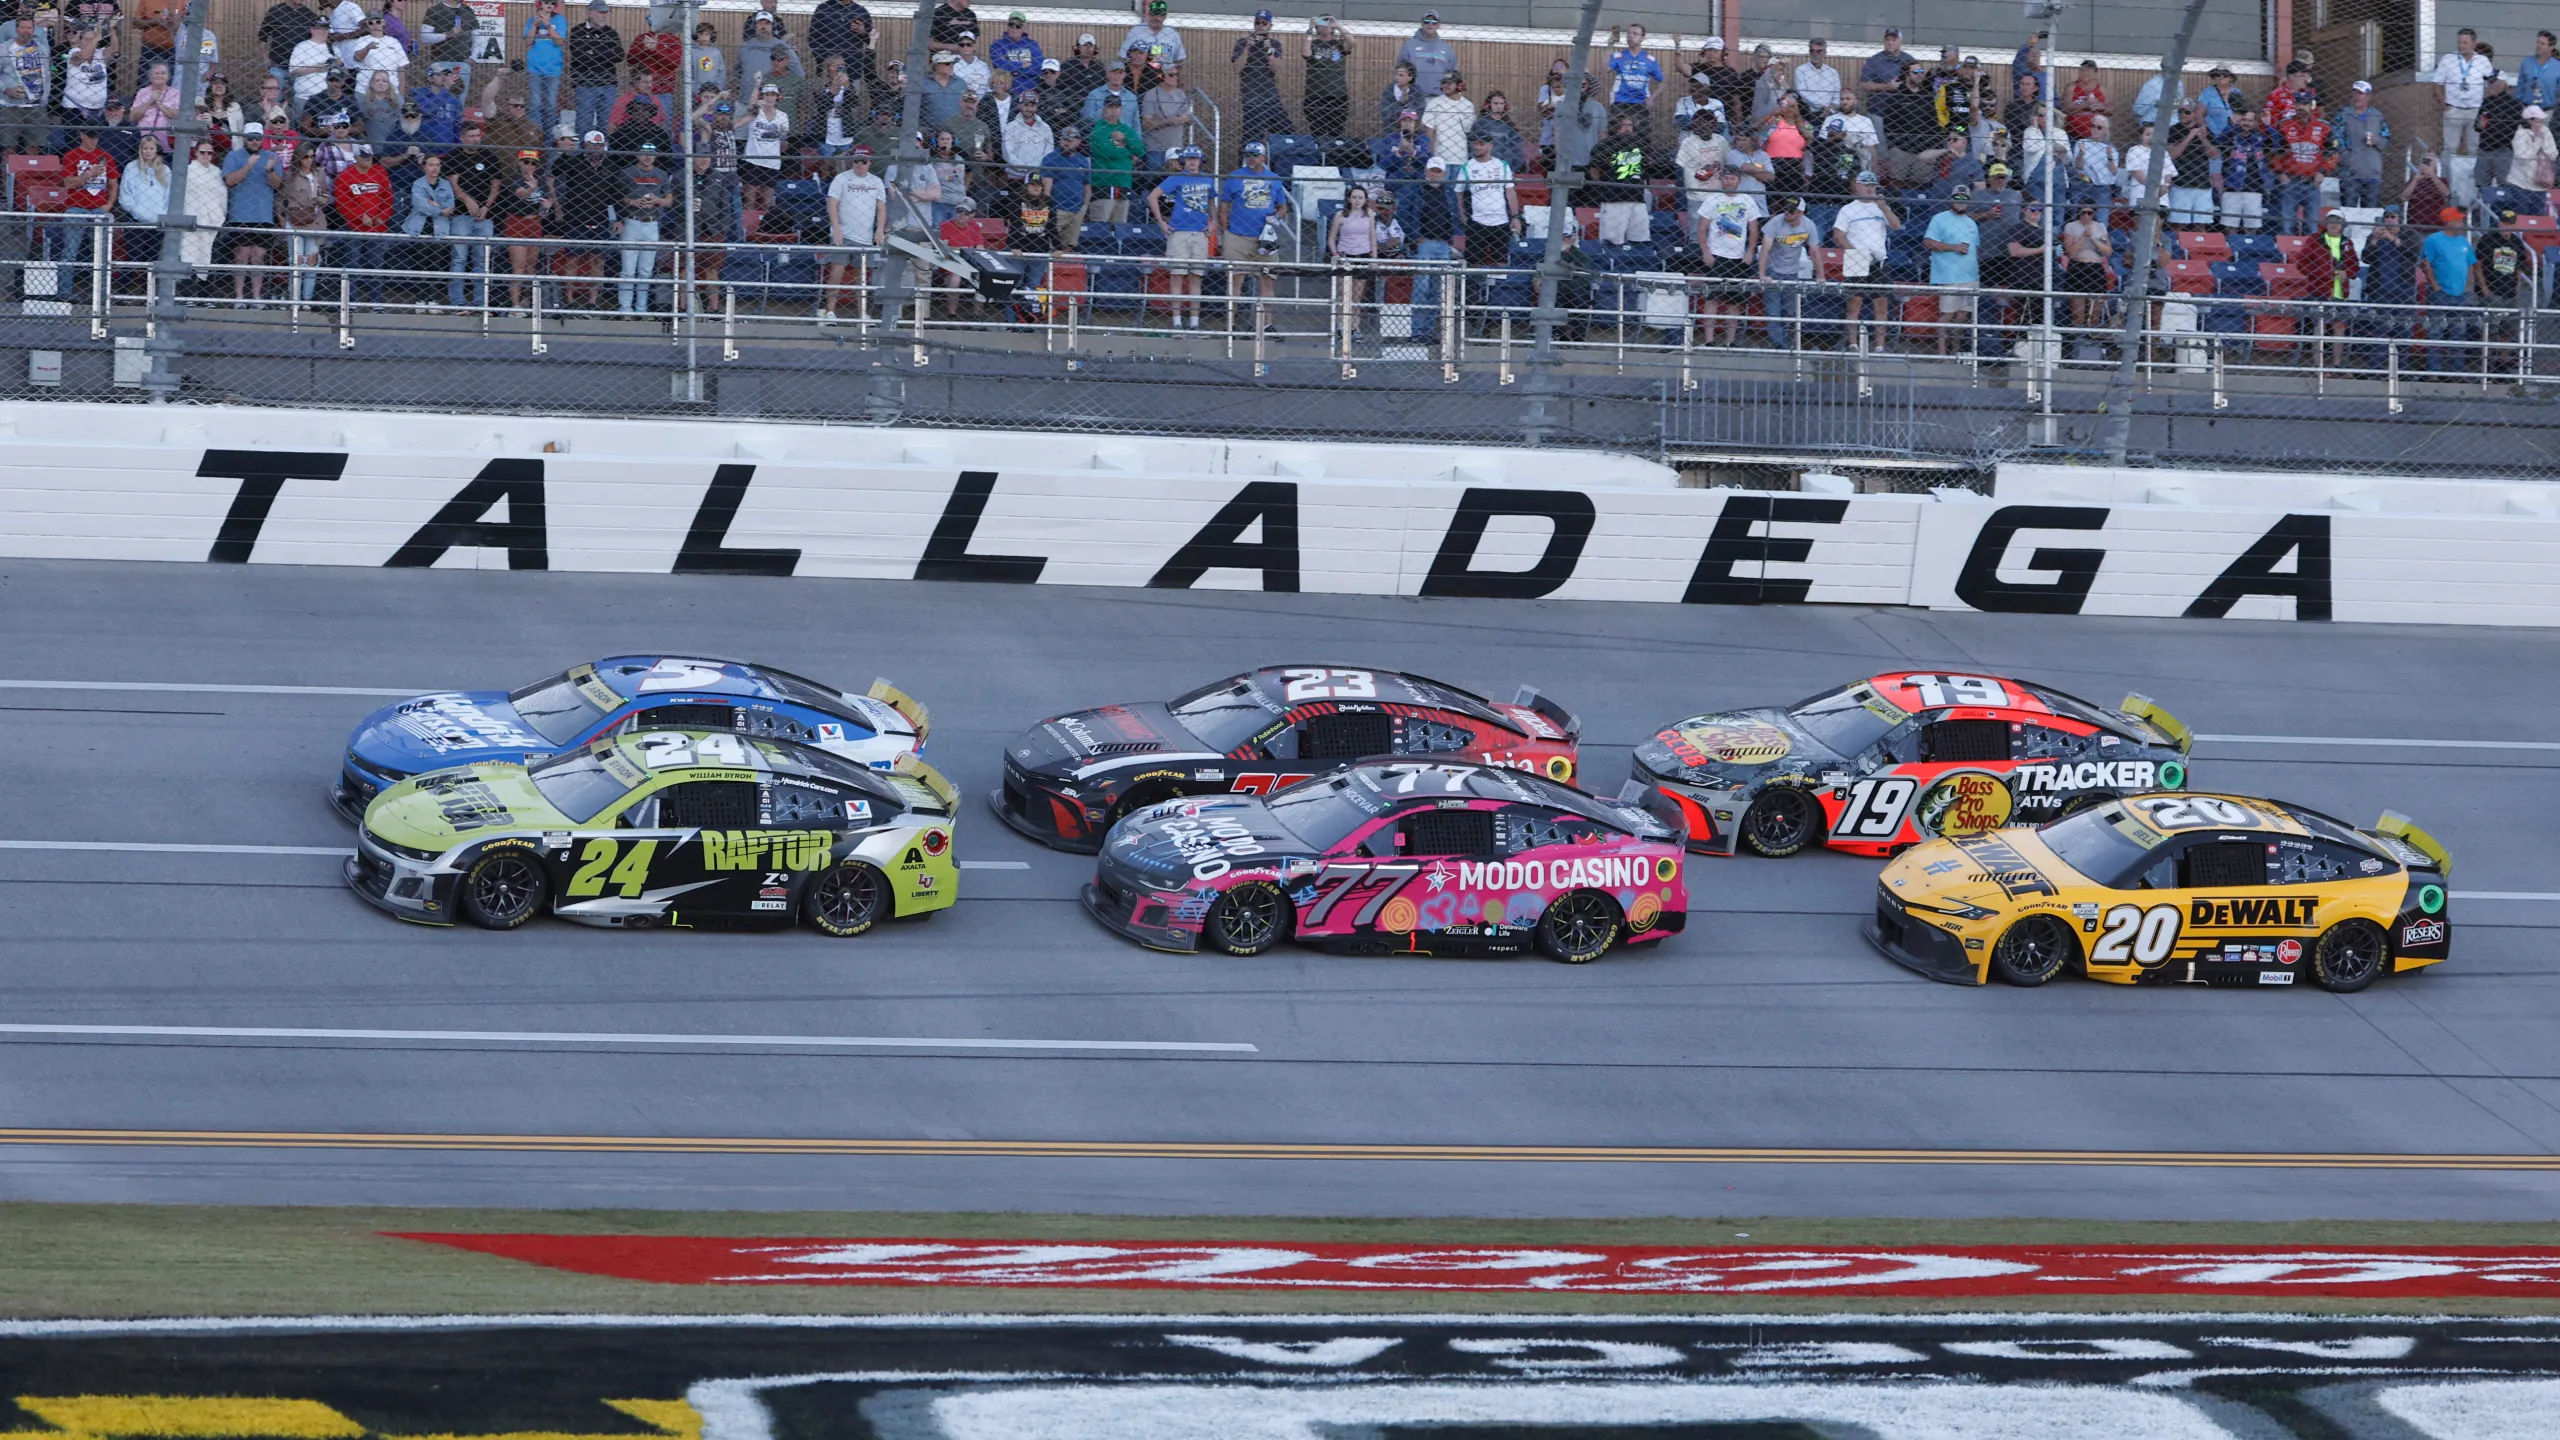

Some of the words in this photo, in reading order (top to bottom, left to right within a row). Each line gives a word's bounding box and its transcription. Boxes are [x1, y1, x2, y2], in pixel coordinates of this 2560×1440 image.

[195, 449, 2332, 621] TALLADEGA
[637, 658, 726, 691] 5
[1285, 667, 1377, 701] 23
[586, 683, 613, 705] LARSON
[1904, 674, 2009, 707] 19
[1250, 689, 1283, 715] WALLACE
[1868, 699, 1903, 722] BRISCOE
[1257, 721, 1285, 741] Robinhood
[641, 731, 752, 768] 24
[1656, 729, 1709, 767] CLUB
[608, 760, 635, 780] BYRON
[1133, 769, 1186, 782] GOODYEAR
[1389, 763, 1480, 794] 77
[1766, 774, 1816, 785] GOODYEAR
[2015, 761, 2155, 791] TRACKER
[781, 777, 839, 795] HendrickCars.com
[1957, 777, 1994, 797] Bass
[1342, 787, 1380, 815] HOCEVAR
[1688, 793, 1711, 804] JGR
[1836, 779, 1915, 835] 19
[1956, 794, 1985, 813] Pro
[2020, 796, 2063, 808] ATVs
[1953, 810, 1999, 833] Shops
[2135, 795, 2253, 829] 20
[482, 838, 535, 852] GOODYEAR
[1201, 817, 1265, 856] MODO
[2131, 828, 2156, 846] BELL
[700, 830, 833, 872] RAPTOR
[1160, 821, 1231, 882] CASINO
[566, 837, 658, 898] 24
[840, 860, 869, 869] EAGLE
[1229, 866, 1283, 879] GOODYEAR
[1459, 860, 1545, 891] MODO
[1551, 856, 1650, 889] CASINO
[911, 890, 939, 898] LIBERTY
[1225, 880, 1281, 896] GOODYEAR
[1303, 862, 1420, 927] 77
[1877, 886, 1903, 912] CAMRY
[1550, 891, 1573, 912] EAGLE
[2018, 902, 2068, 913] GOODYEAR
[816, 915, 871, 935] GOODYEAR
[1445, 926, 1479, 935] ZEIGLER
[1940, 921, 1964, 932] JGR
[2091, 904, 2182, 966] 20
[1229, 945, 1257, 955] EAGLE
[1570, 924, 1618, 963] GOODYEAR
[2278, 940, 2301, 960] Rheem
[2041, 959, 2064, 982] EAGLE
[2262, 974, 2283, 982] Mobil
